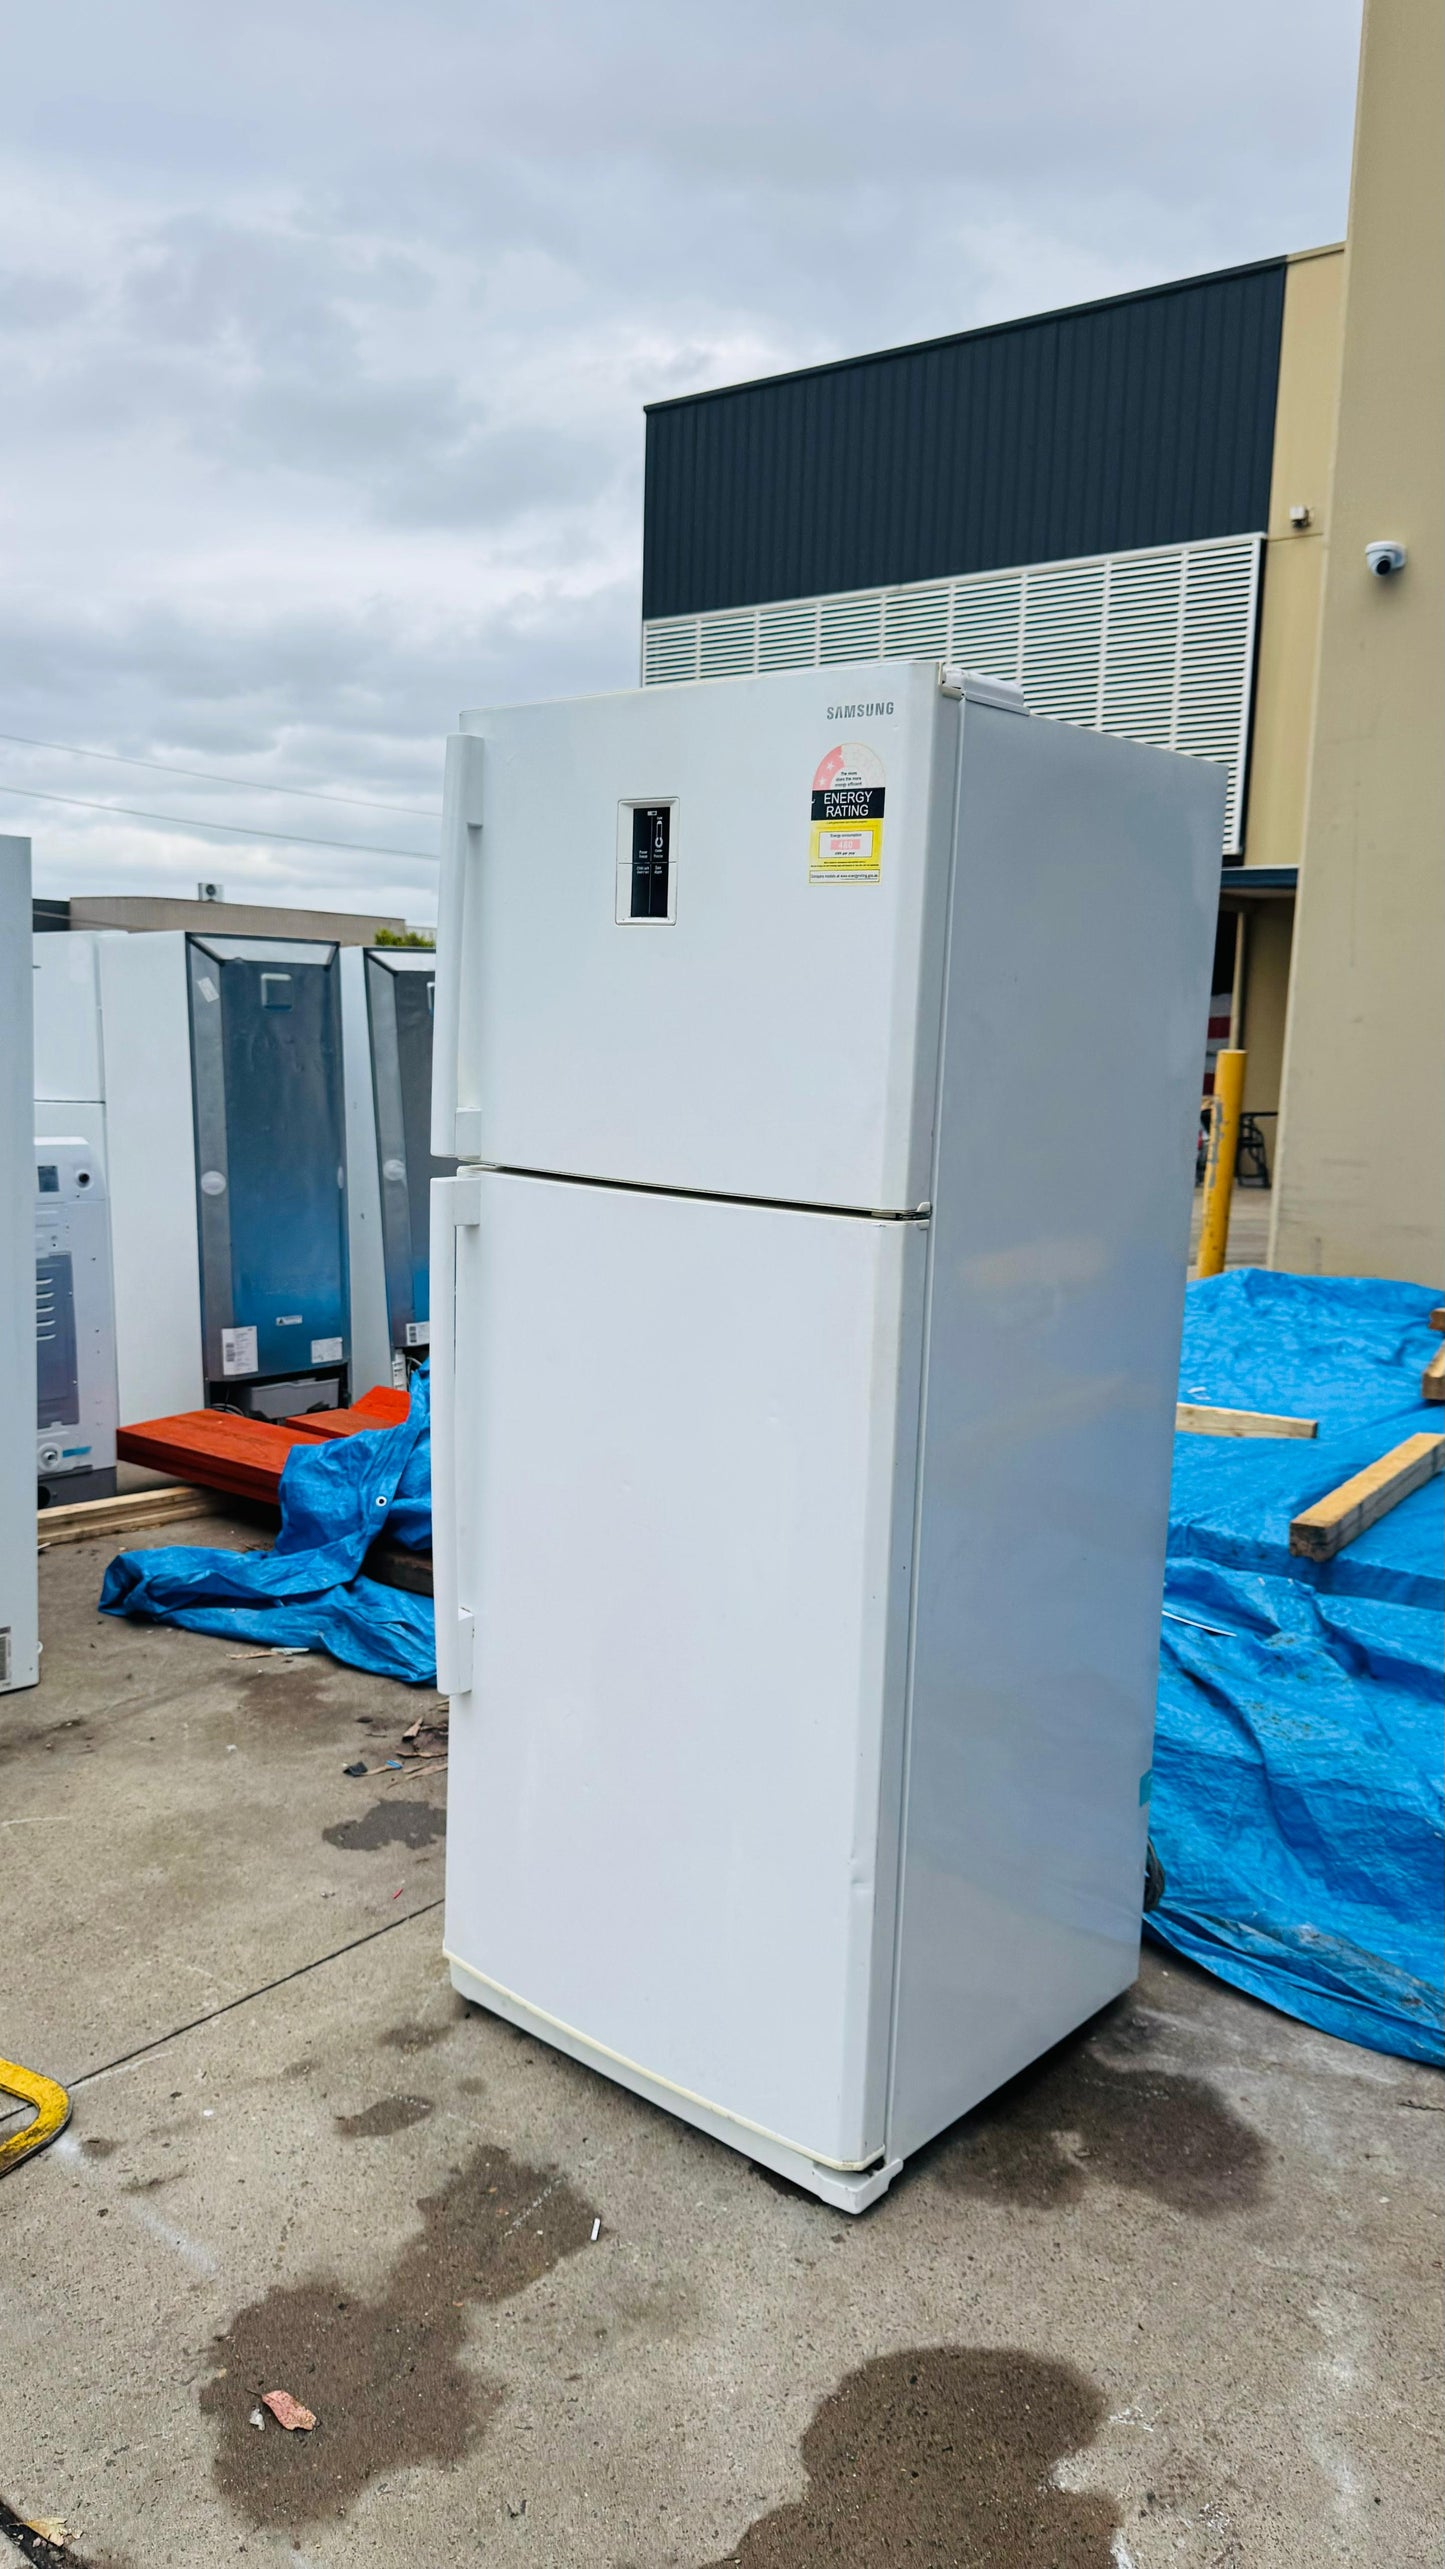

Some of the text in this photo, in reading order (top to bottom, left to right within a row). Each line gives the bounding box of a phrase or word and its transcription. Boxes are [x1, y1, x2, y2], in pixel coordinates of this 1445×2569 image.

[827, 701, 894, 720] SAMSUNG
[823, 790, 873, 805] ENERGY
[825, 804, 869, 818] RATING
